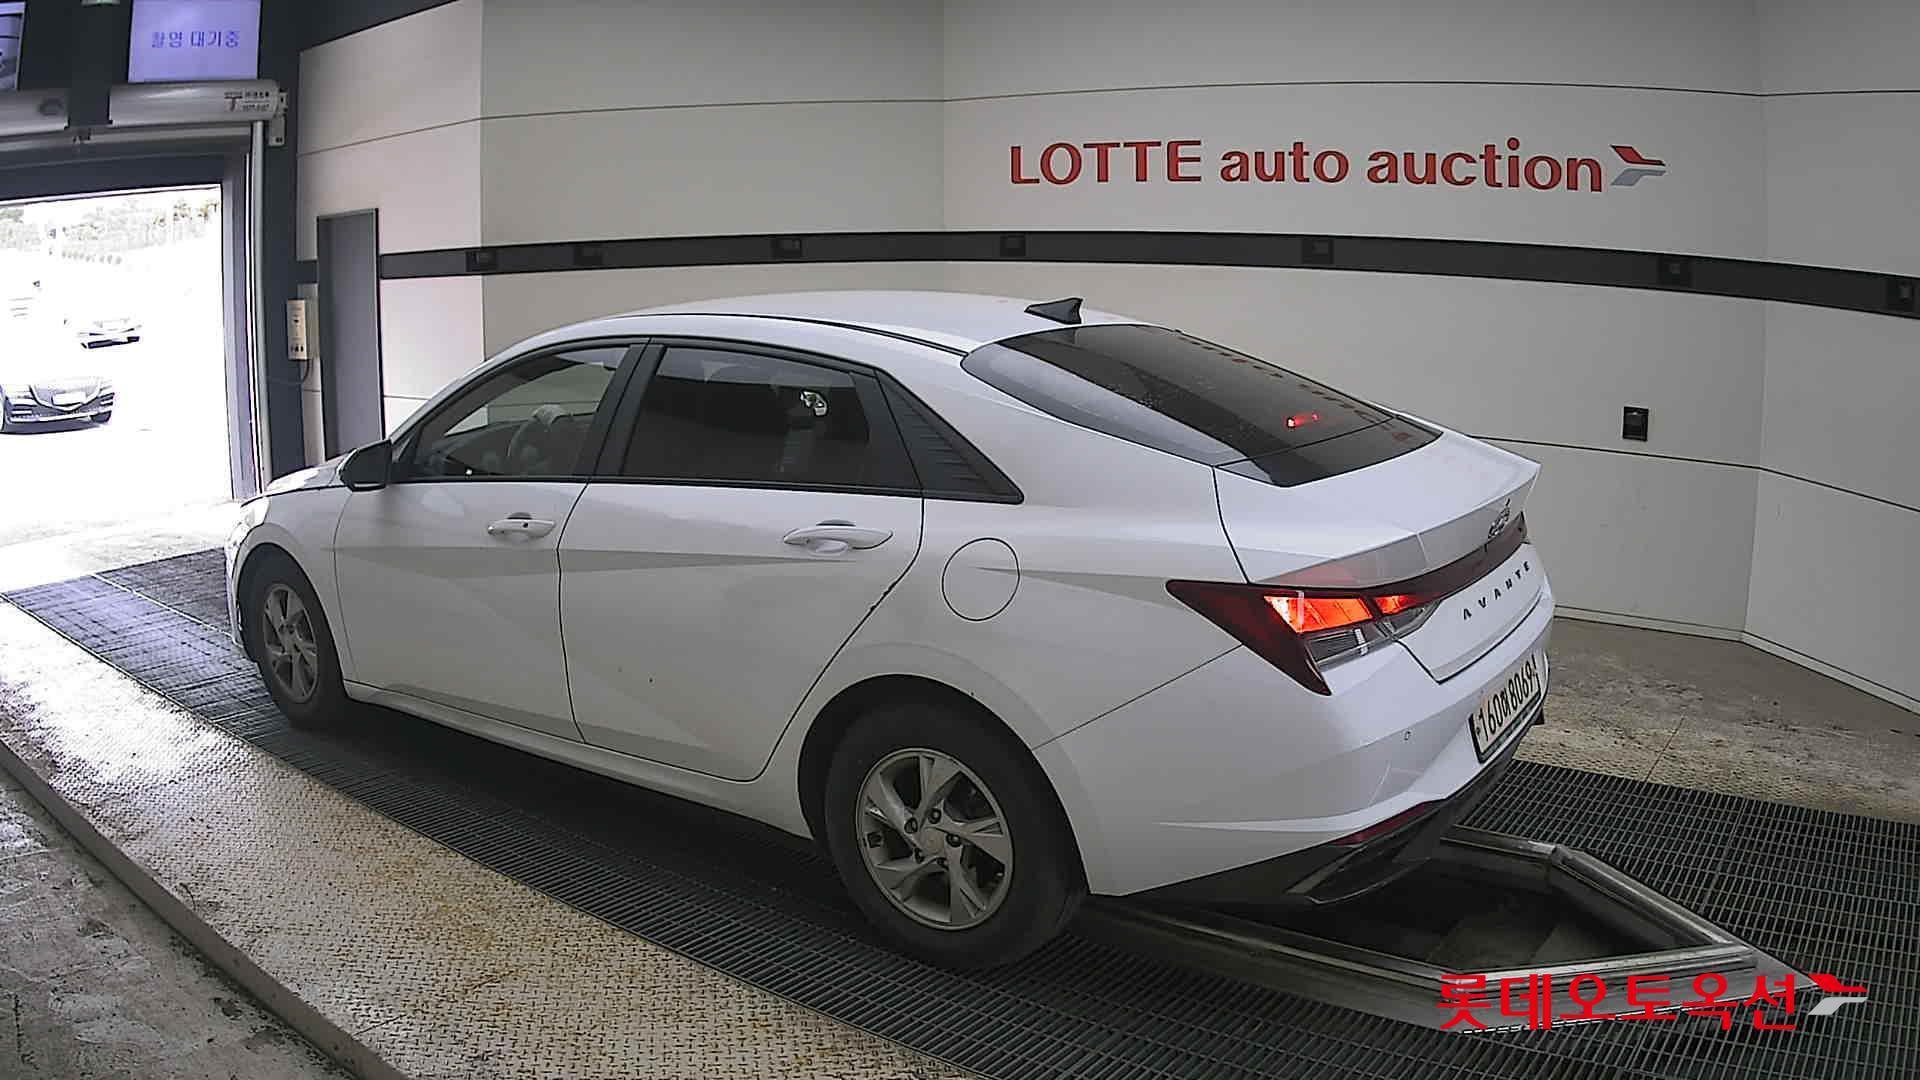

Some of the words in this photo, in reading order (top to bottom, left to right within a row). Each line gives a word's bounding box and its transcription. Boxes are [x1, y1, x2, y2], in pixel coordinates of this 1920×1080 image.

[191, 30, 240, 48] 대기중
[1010, 140, 1202, 185] LOTTE
[1219, 141, 1350, 184] auto
[1366, 137, 1603, 193] auction
[1462, 561, 1531, 621] AVANTE
